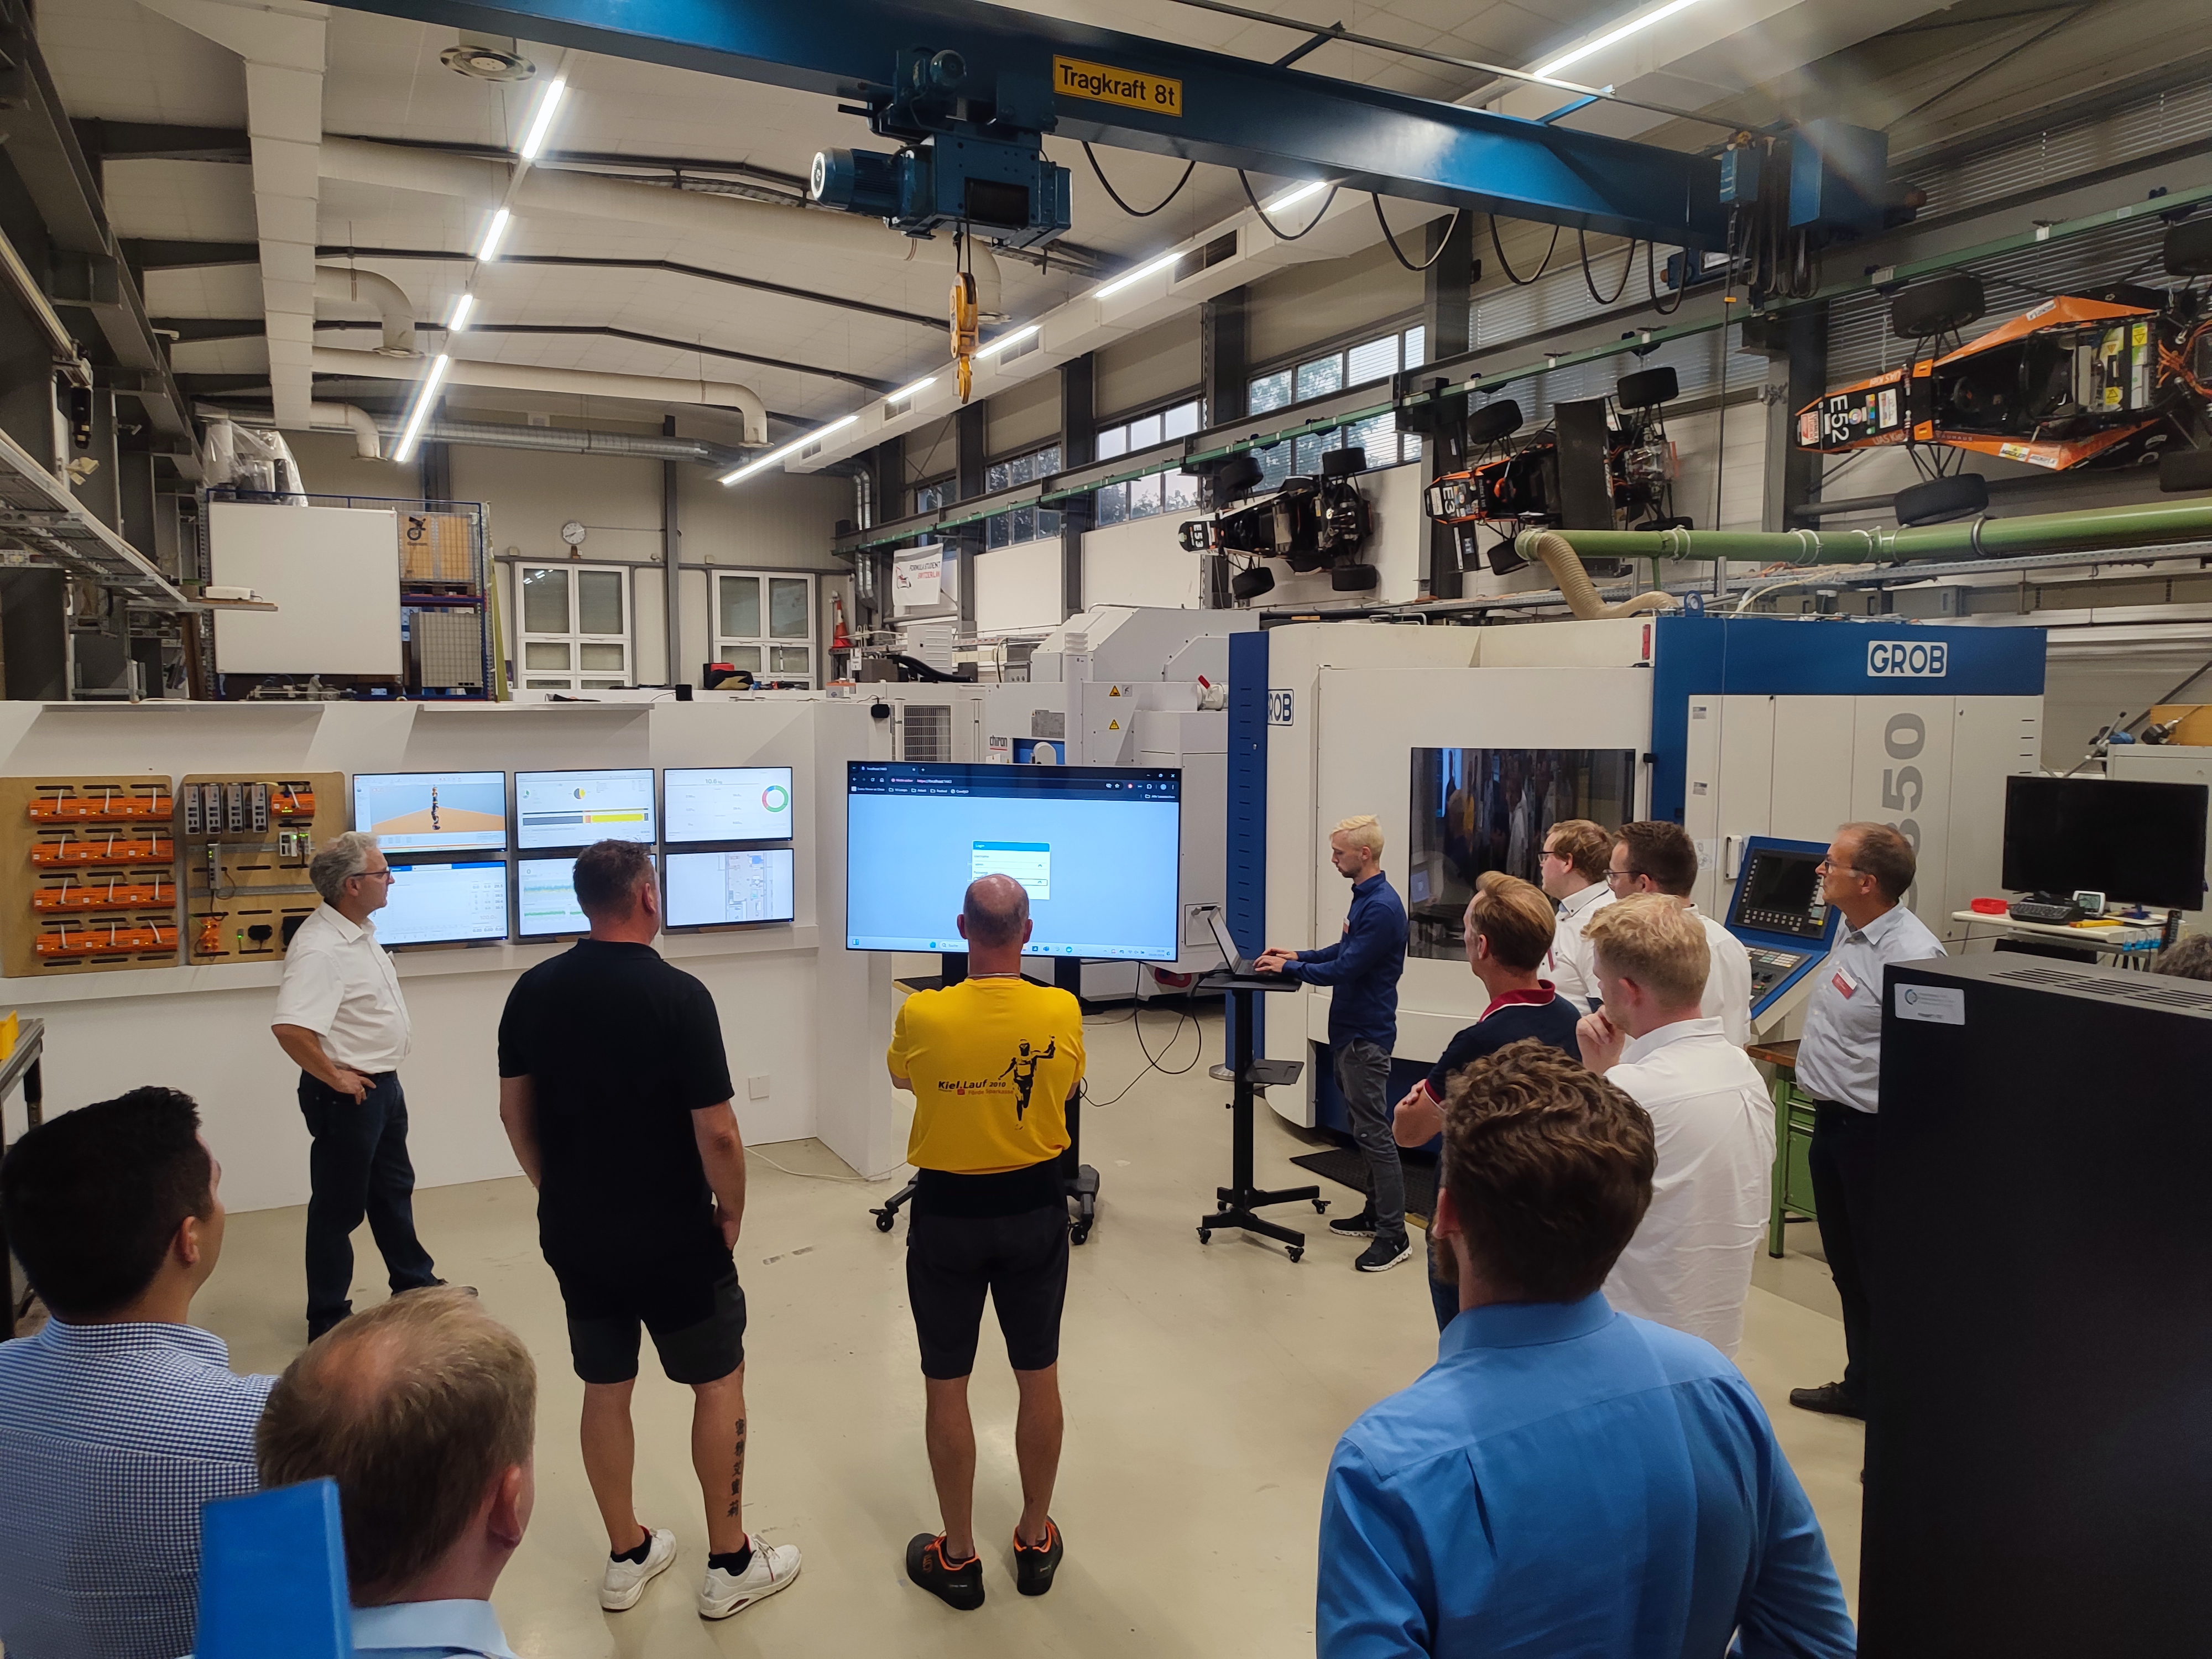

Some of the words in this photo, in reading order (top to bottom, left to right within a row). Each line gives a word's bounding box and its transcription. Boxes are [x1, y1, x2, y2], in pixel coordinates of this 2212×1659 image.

[1060, 64, 1146, 101] Tragkraft
[1155, 84, 1175, 106] 8t
[1830, 394, 1850, 444] E52
[1872, 434, 1891, 446] UAS
[1442, 486, 1455, 514] E3
[1193, 524, 1204, 548] E53
[1870, 643, 1945, 674] GROB
[1269, 693, 1292, 722] ROB
